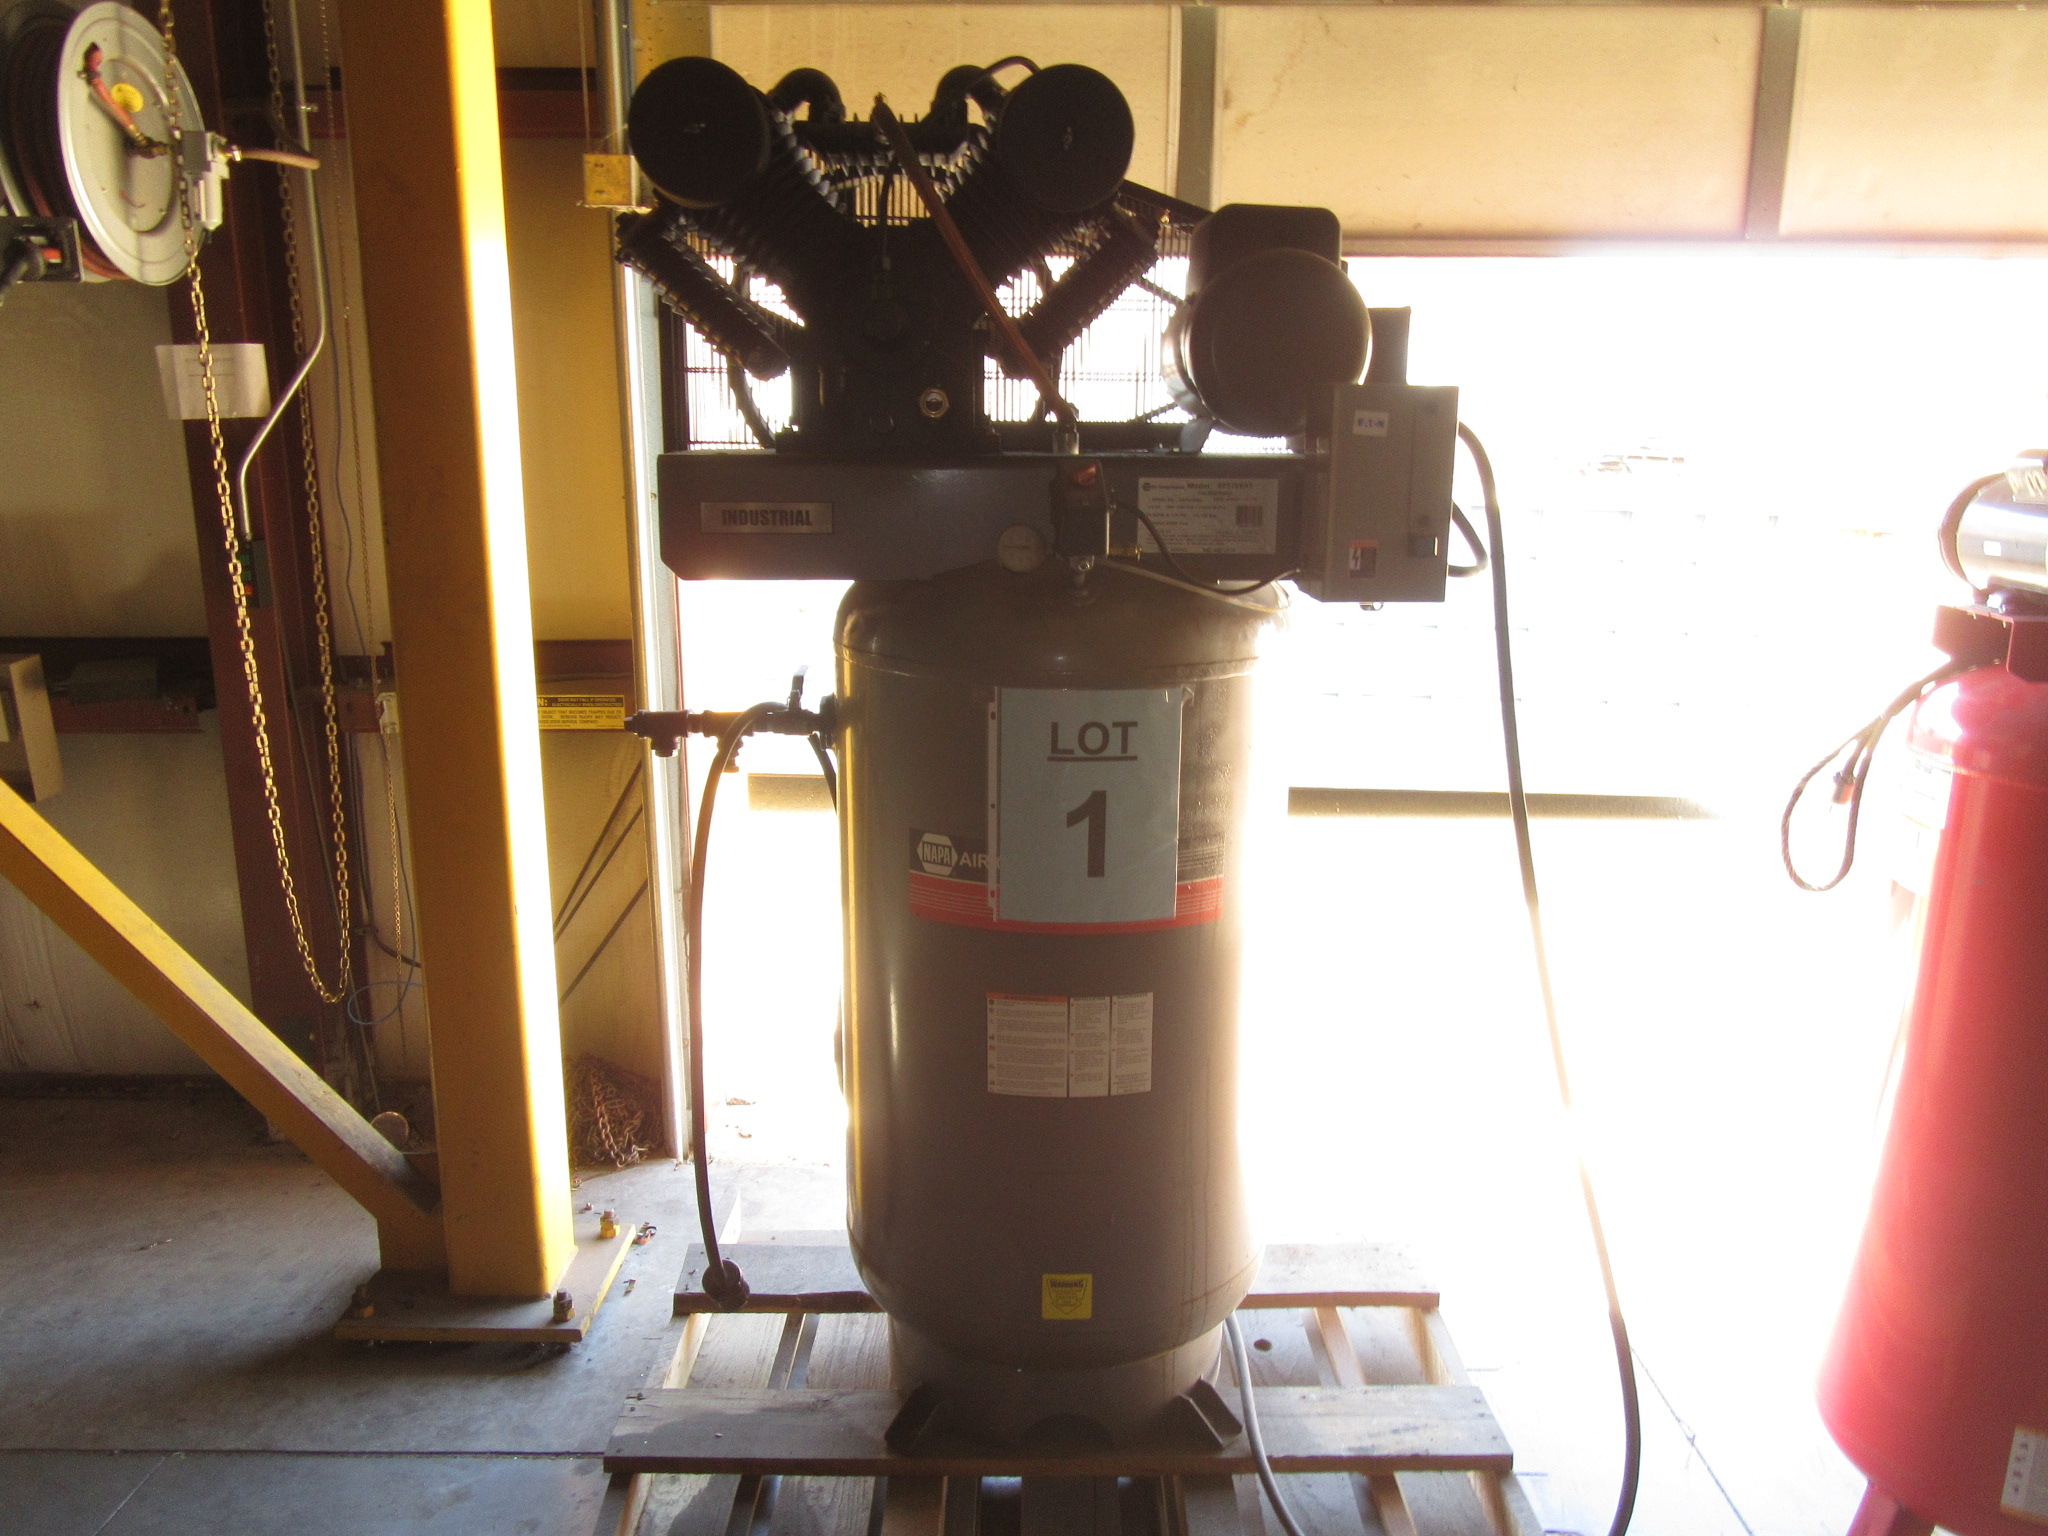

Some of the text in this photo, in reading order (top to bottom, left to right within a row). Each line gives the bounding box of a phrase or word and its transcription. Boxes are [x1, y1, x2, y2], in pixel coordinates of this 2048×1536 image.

[721, 509, 812, 526] INDUSTRIAL
[1049, 720, 1138, 756] LOT
[1066, 790, 1107, 878] 1
[923, 842, 951, 865] NAPA
[959, 851, 989, 869] AIR
